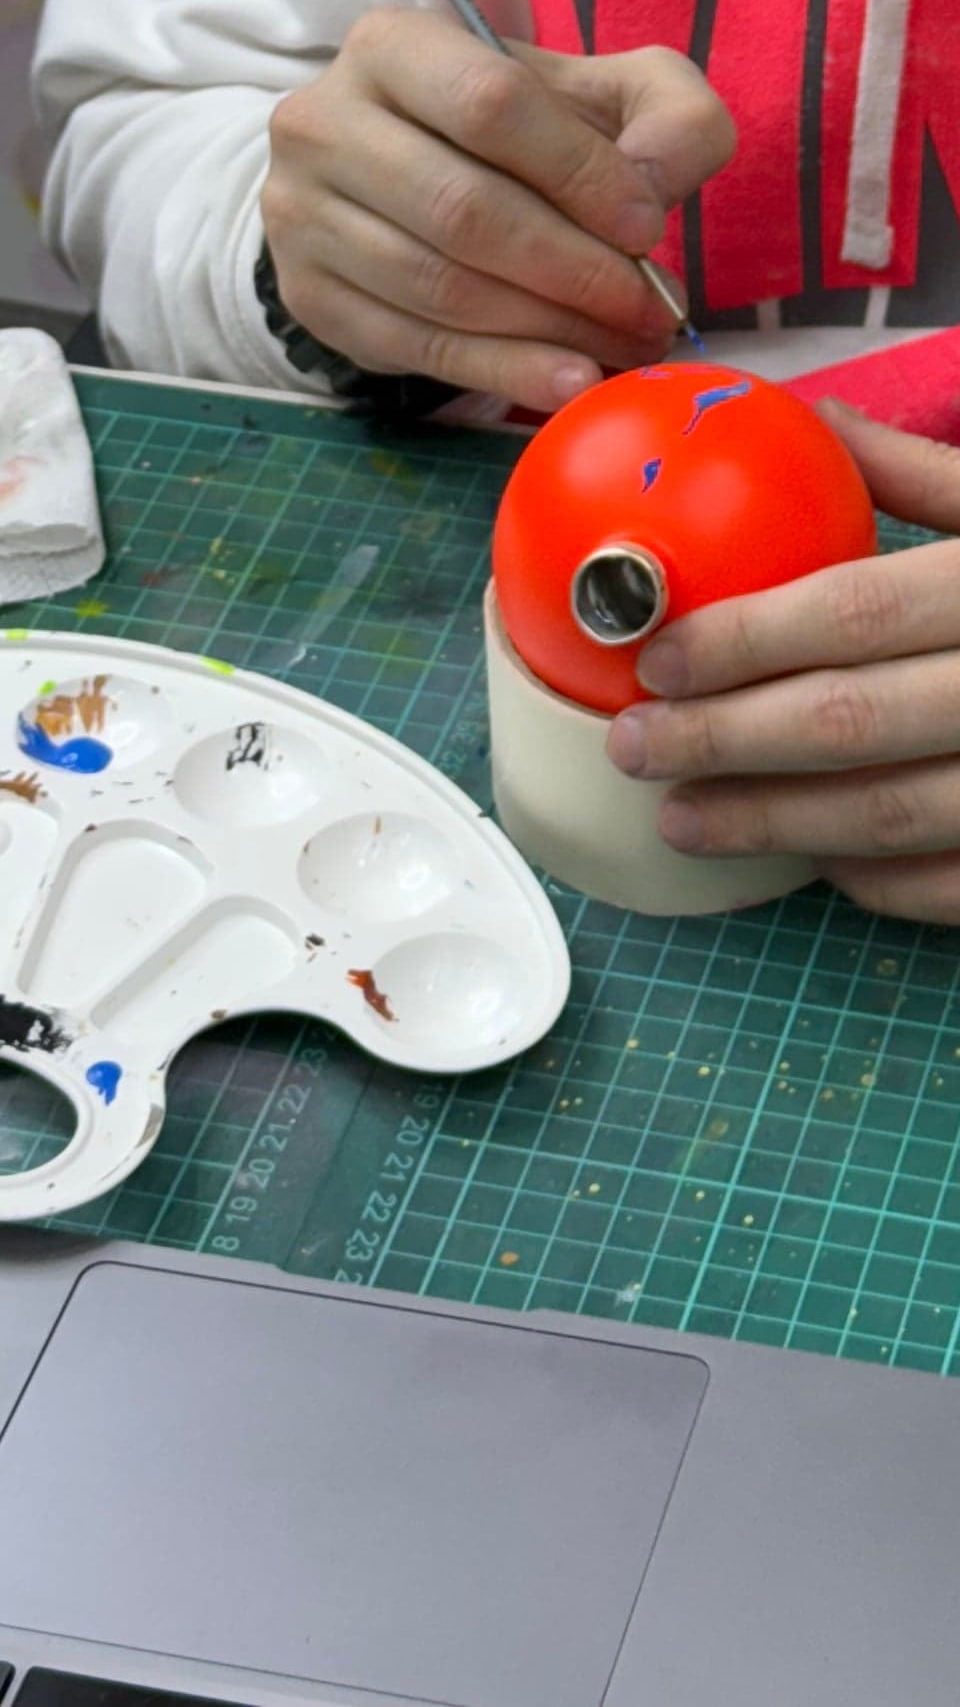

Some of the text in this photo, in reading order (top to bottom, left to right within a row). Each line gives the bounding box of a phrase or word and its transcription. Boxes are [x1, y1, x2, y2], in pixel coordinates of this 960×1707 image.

[277, 1083, 312, 1114] 22
[396, 1115, 430, 1145] 20
[241, 1158, 276, 1190] 20
[380, 1152, 414, 1181] 21
[225, 1196, 259, 1226] 19
[361, 1190, 397, 1222] 22
[212, 1235, 241, 1252] 8
[345, 1228, 381, 1262] 23
[334, 1268, 363, 1286] 2
